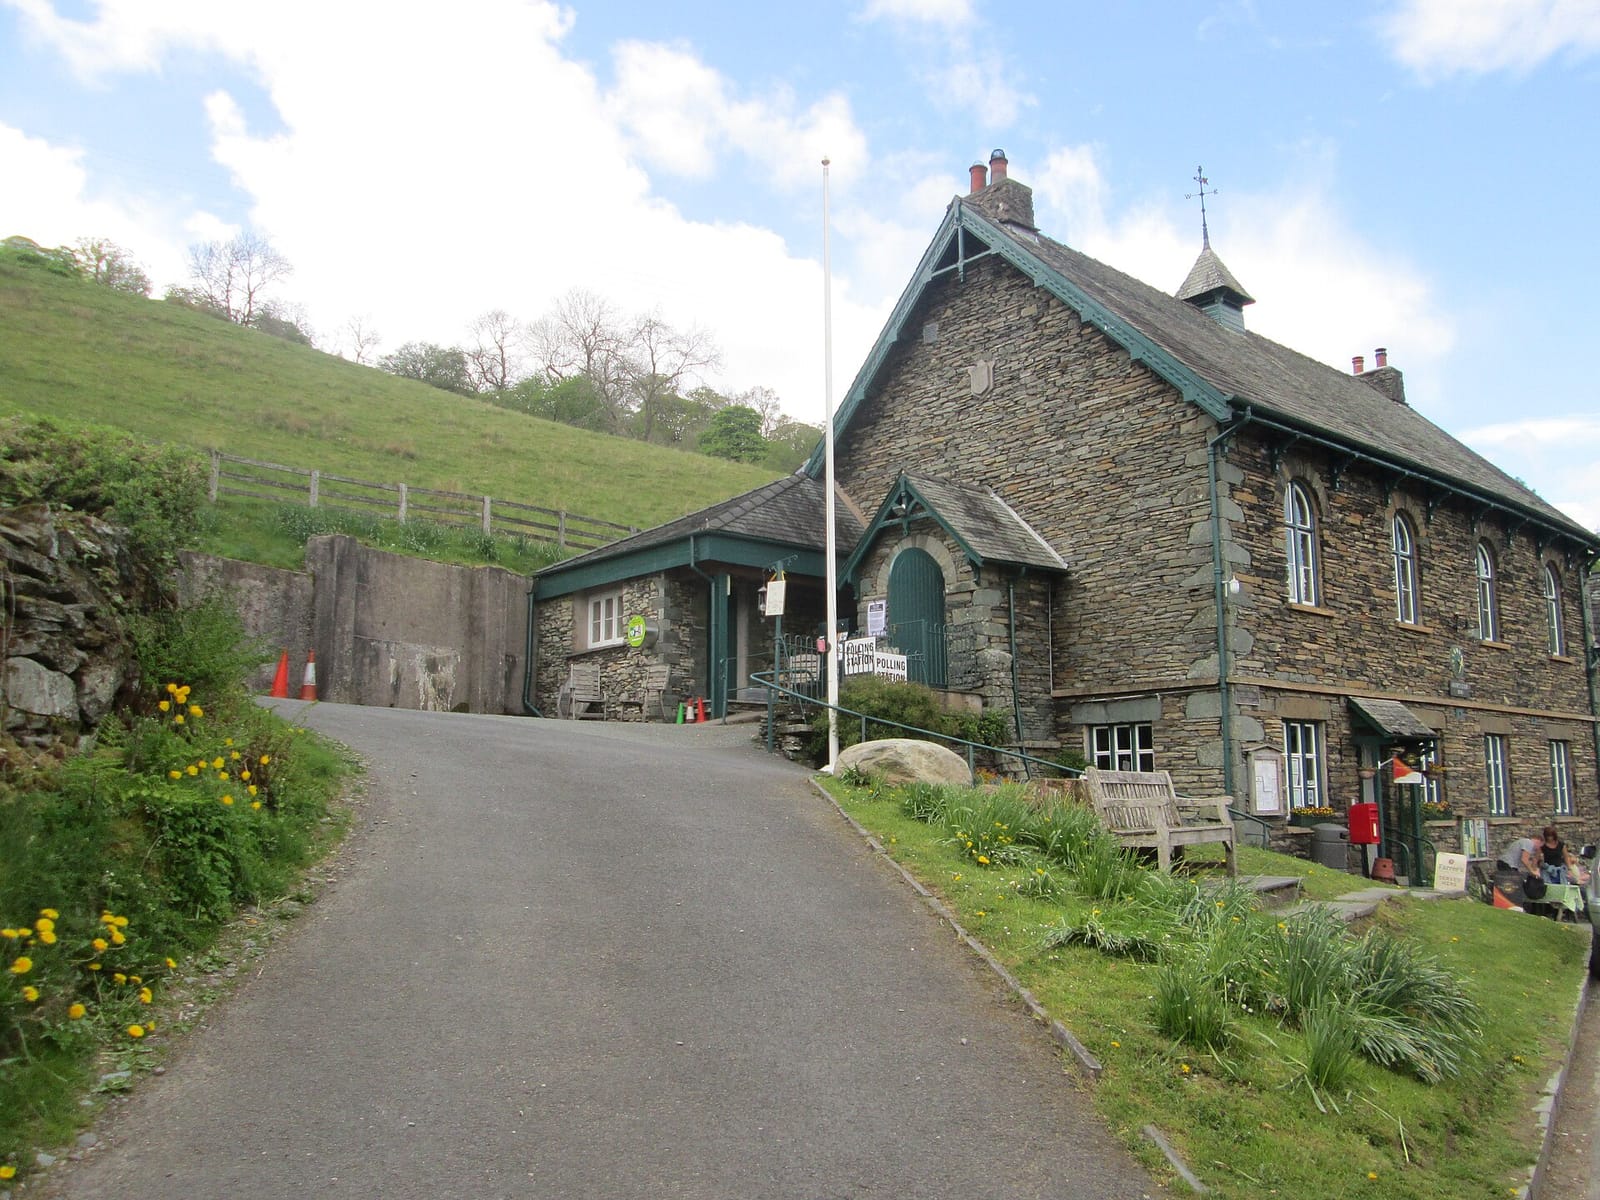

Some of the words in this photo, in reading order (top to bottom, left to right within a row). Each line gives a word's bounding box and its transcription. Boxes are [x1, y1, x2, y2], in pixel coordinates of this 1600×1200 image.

[847, 642, 873, 655] POLLING
[847, 654, 874, 666] STATION
[877, 658, 905, 670] POLLING
